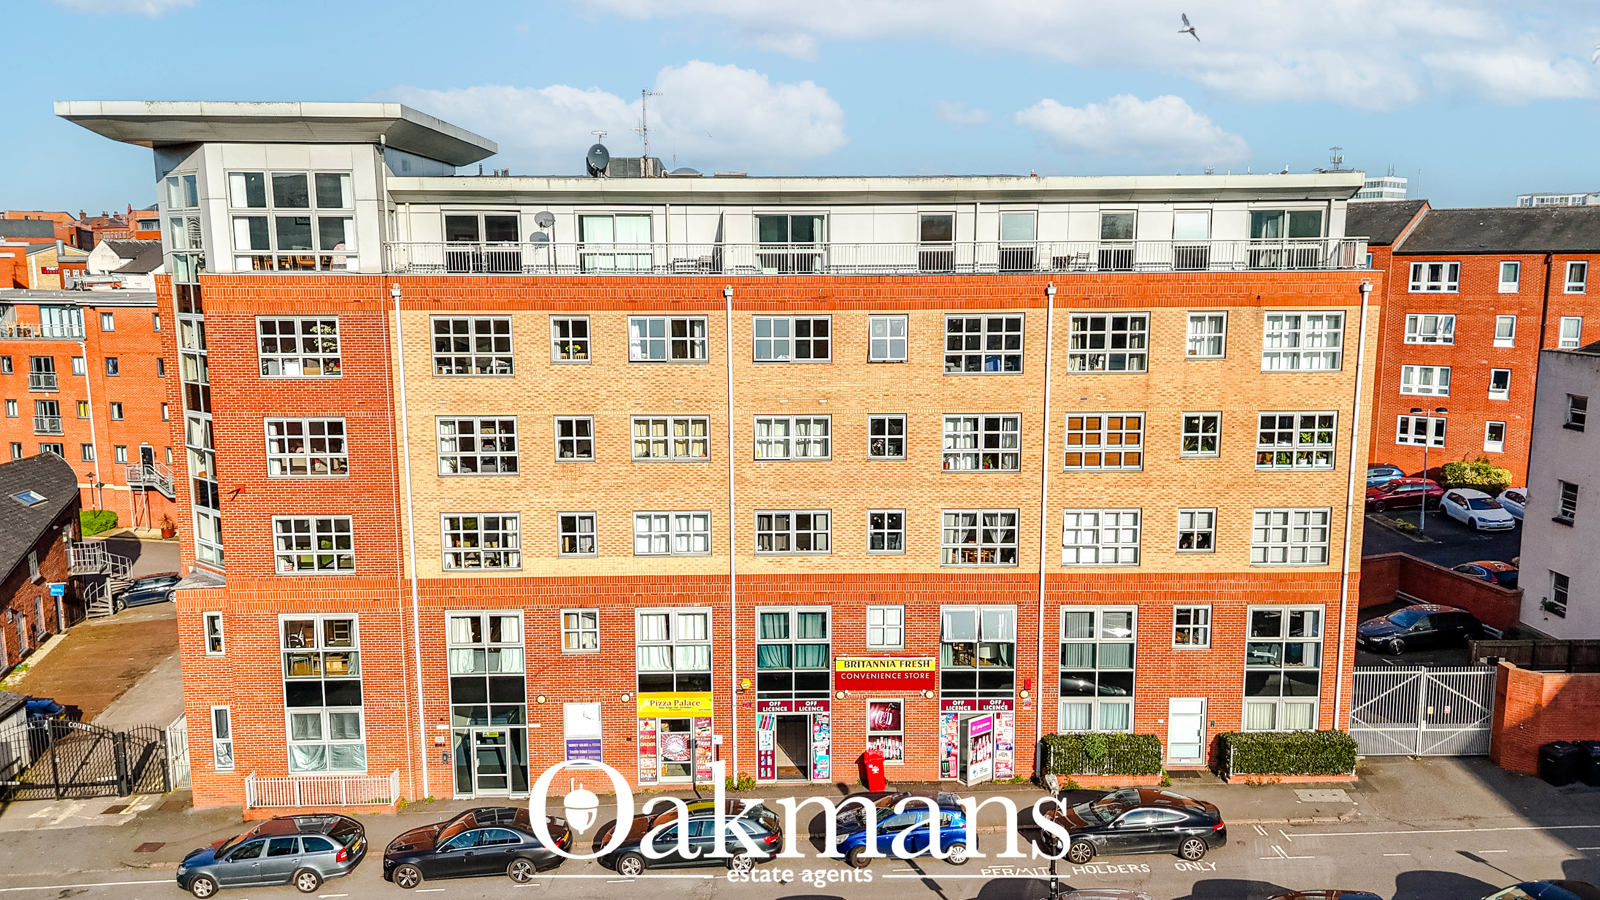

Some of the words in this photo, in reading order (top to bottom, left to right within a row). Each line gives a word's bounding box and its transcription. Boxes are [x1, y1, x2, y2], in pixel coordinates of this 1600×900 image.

[843, 660, 896, 668] BRITANNIA
[899, 659, 930, 668] FRESH
[649, 699, 672, 707] Pizza
[673, 699, 701, 707] Palace
[68, 721, 92, 731] COURT
[980, 866, 1049, 876] PERMIT
[1071, 863, 1151, 875] HOLDERS
[1173, 861, 1217, 872] ONLY
